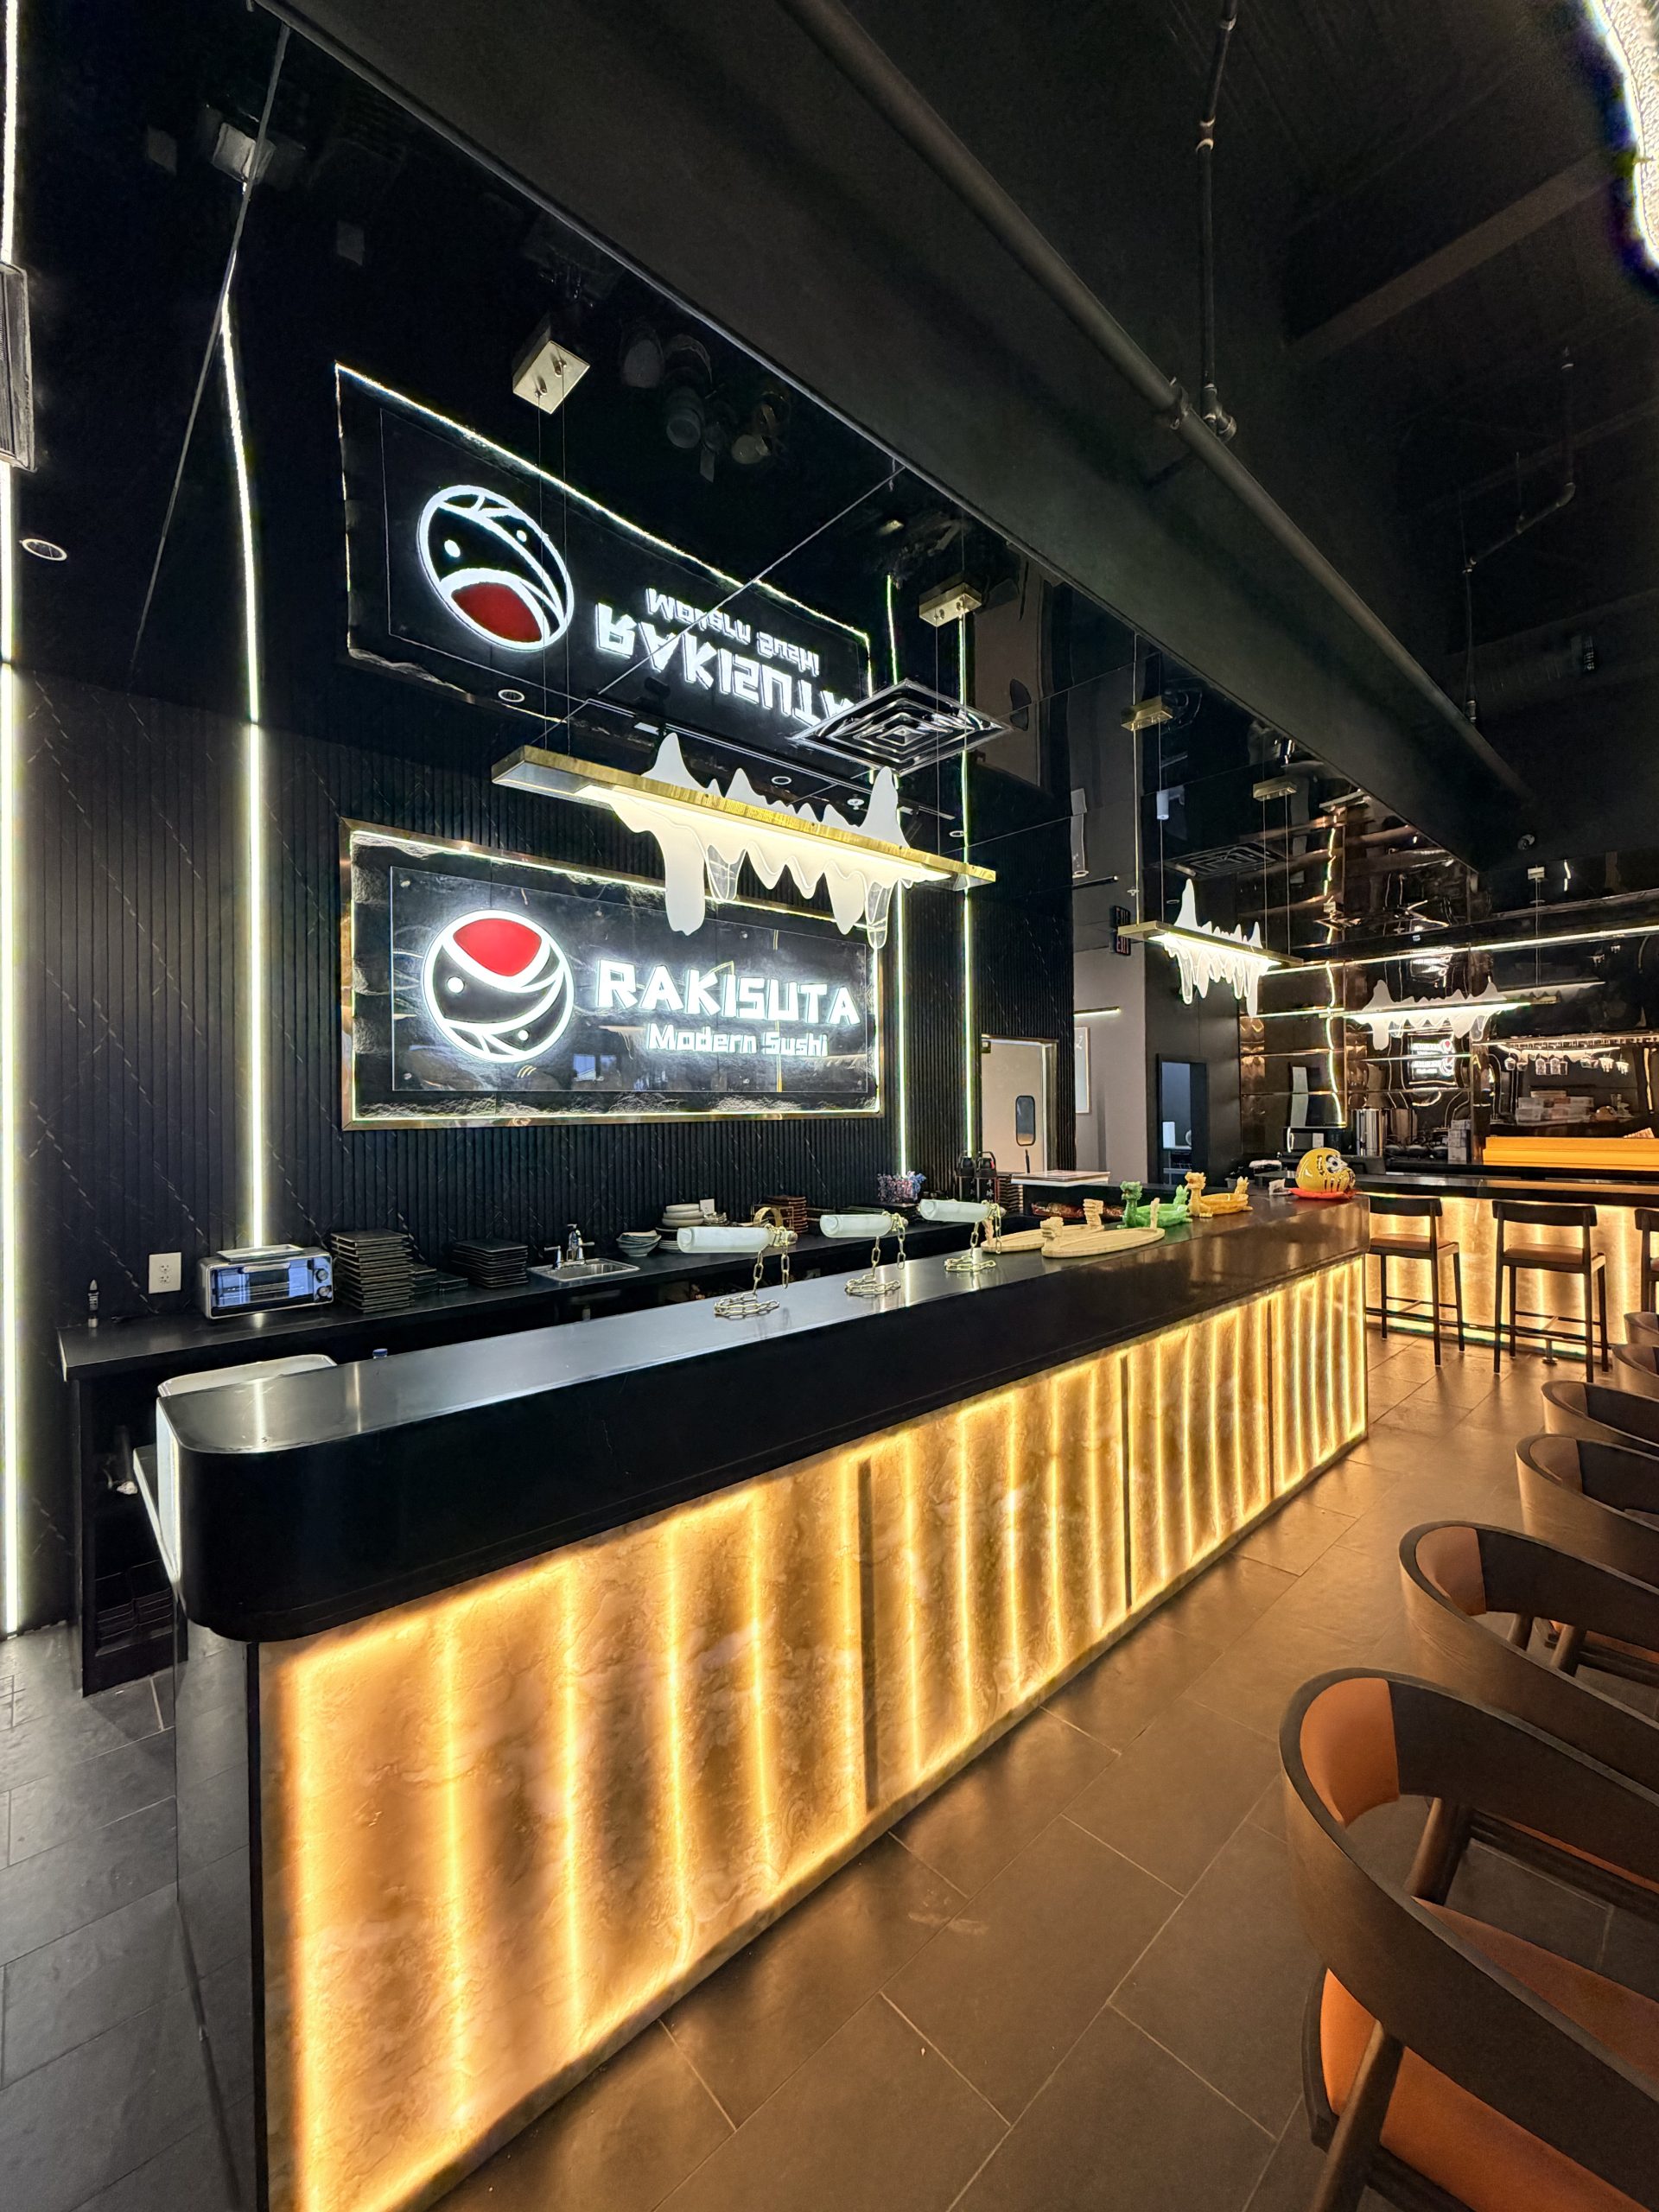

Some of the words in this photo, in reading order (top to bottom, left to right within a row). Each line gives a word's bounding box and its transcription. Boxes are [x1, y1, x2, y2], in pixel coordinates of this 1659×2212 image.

[596, 957, 861, 1026] RAKISUTA
[646, 1022, 757, 1054] Modern
[762, 1030, 830, 1058] Sushi
